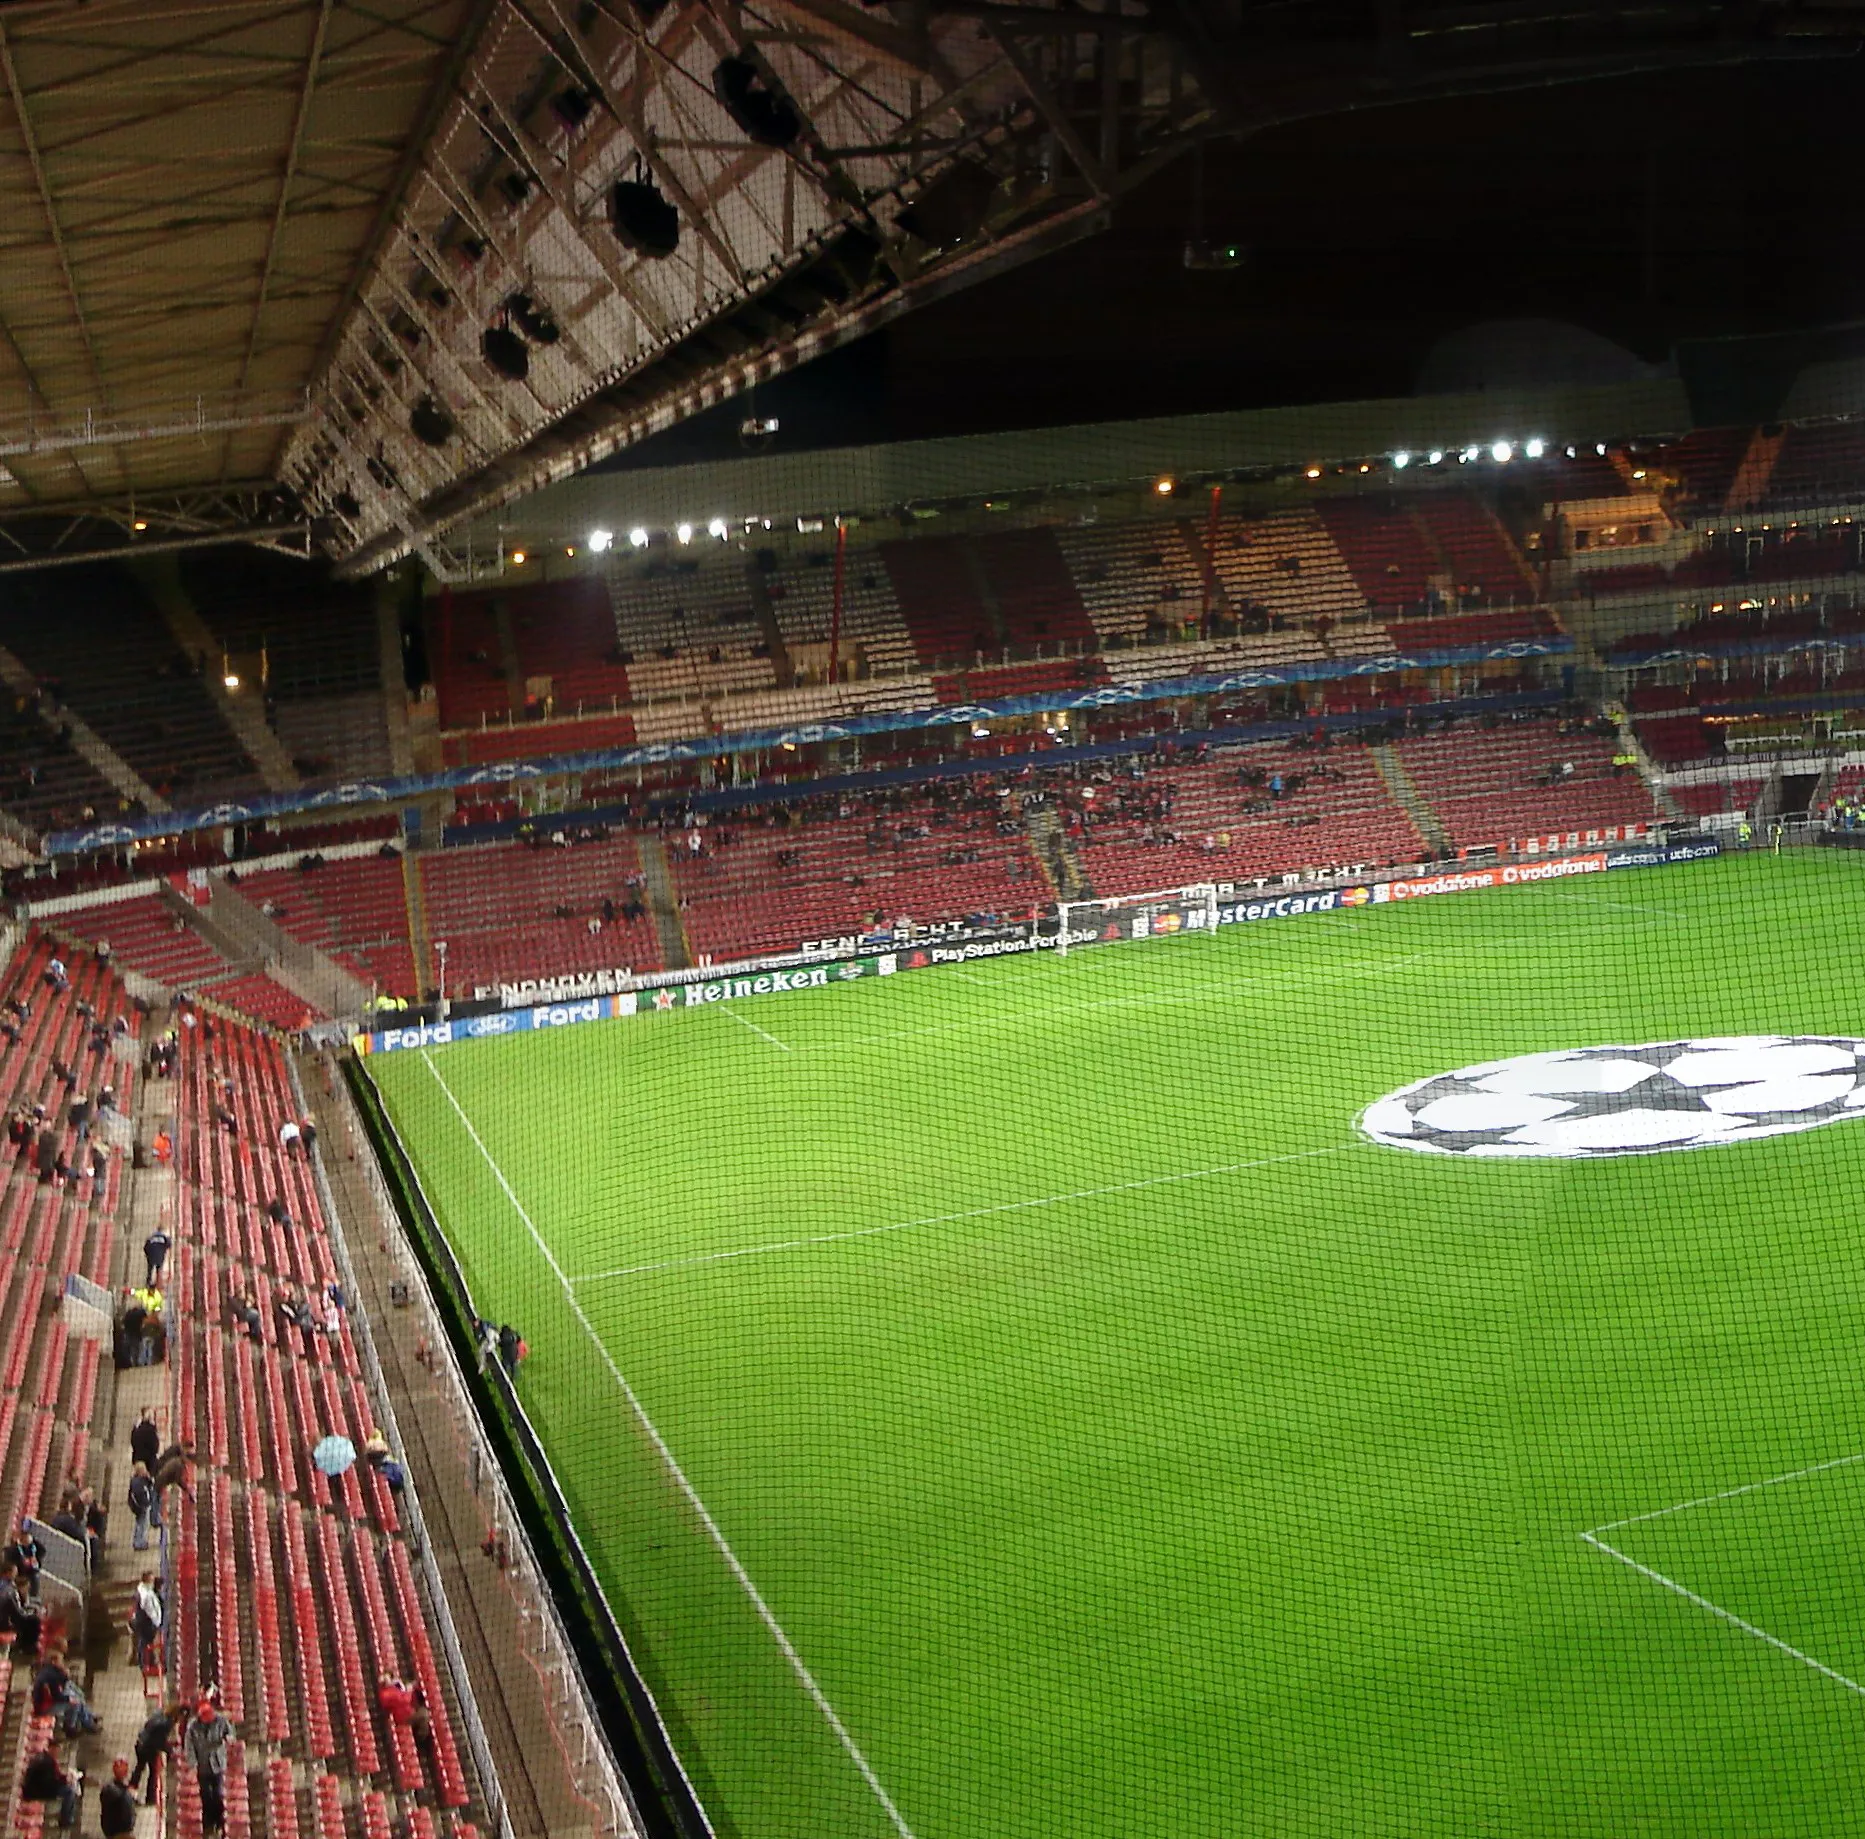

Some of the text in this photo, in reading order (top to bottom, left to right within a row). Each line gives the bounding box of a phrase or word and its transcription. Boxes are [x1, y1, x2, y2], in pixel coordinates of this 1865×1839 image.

[1409, 857, 1601, 896] vodafone vodafone
[683, 967, 828, 1008] Heineken
[383, 1020, 452, 1052] Ford
[531, 998, 600, 1029] Ford
